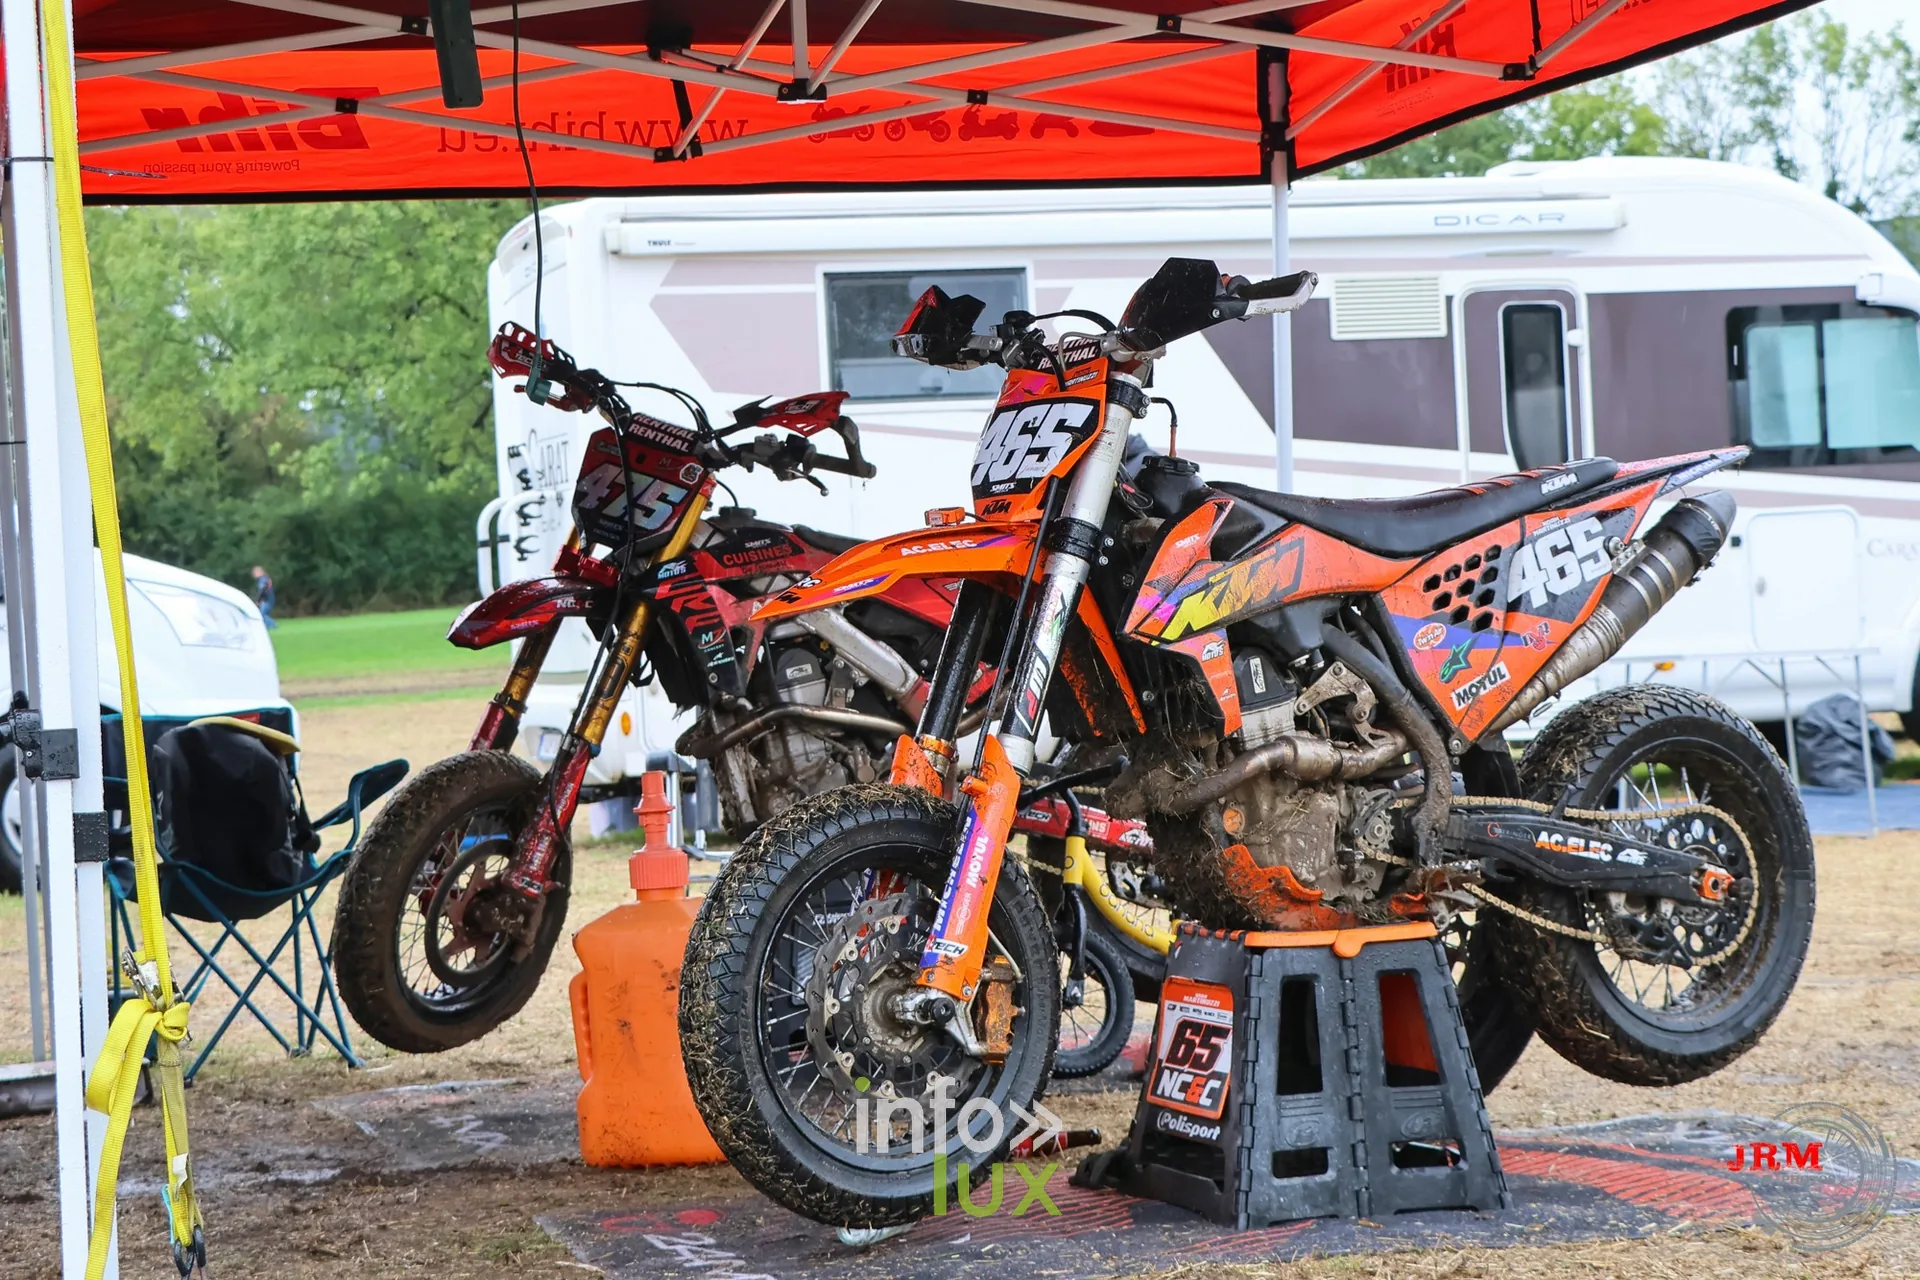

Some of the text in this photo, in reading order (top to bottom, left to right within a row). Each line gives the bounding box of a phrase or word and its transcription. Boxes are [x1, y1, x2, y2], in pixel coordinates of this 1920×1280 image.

[628, 423, 690, 453] RENTHAL
[972, 402, 1094, 487] 465
[577, 463, 689, 531] 475
[1540, 472, 1579, 495] KTM
[980, 499, 1013, 517] KTM
[722, 544, 793, 566] CUISINES
[900, 539, 978, 557] AC.ELEC
[1507, 516, 1612, 609] 465
[1455, 667, 1507, 707] MOTUL
[966, 835, 989, 889] MOTUL
[1535, 831, 1614, 863] AC.ELEC
[1099, 883, 1155, 938] banana
[1163, 1017, 1232, 1074] 65
[1157, 1069, 1221, 1107] NC&C
[1158, 1111, 1221, 1141] Polisport
